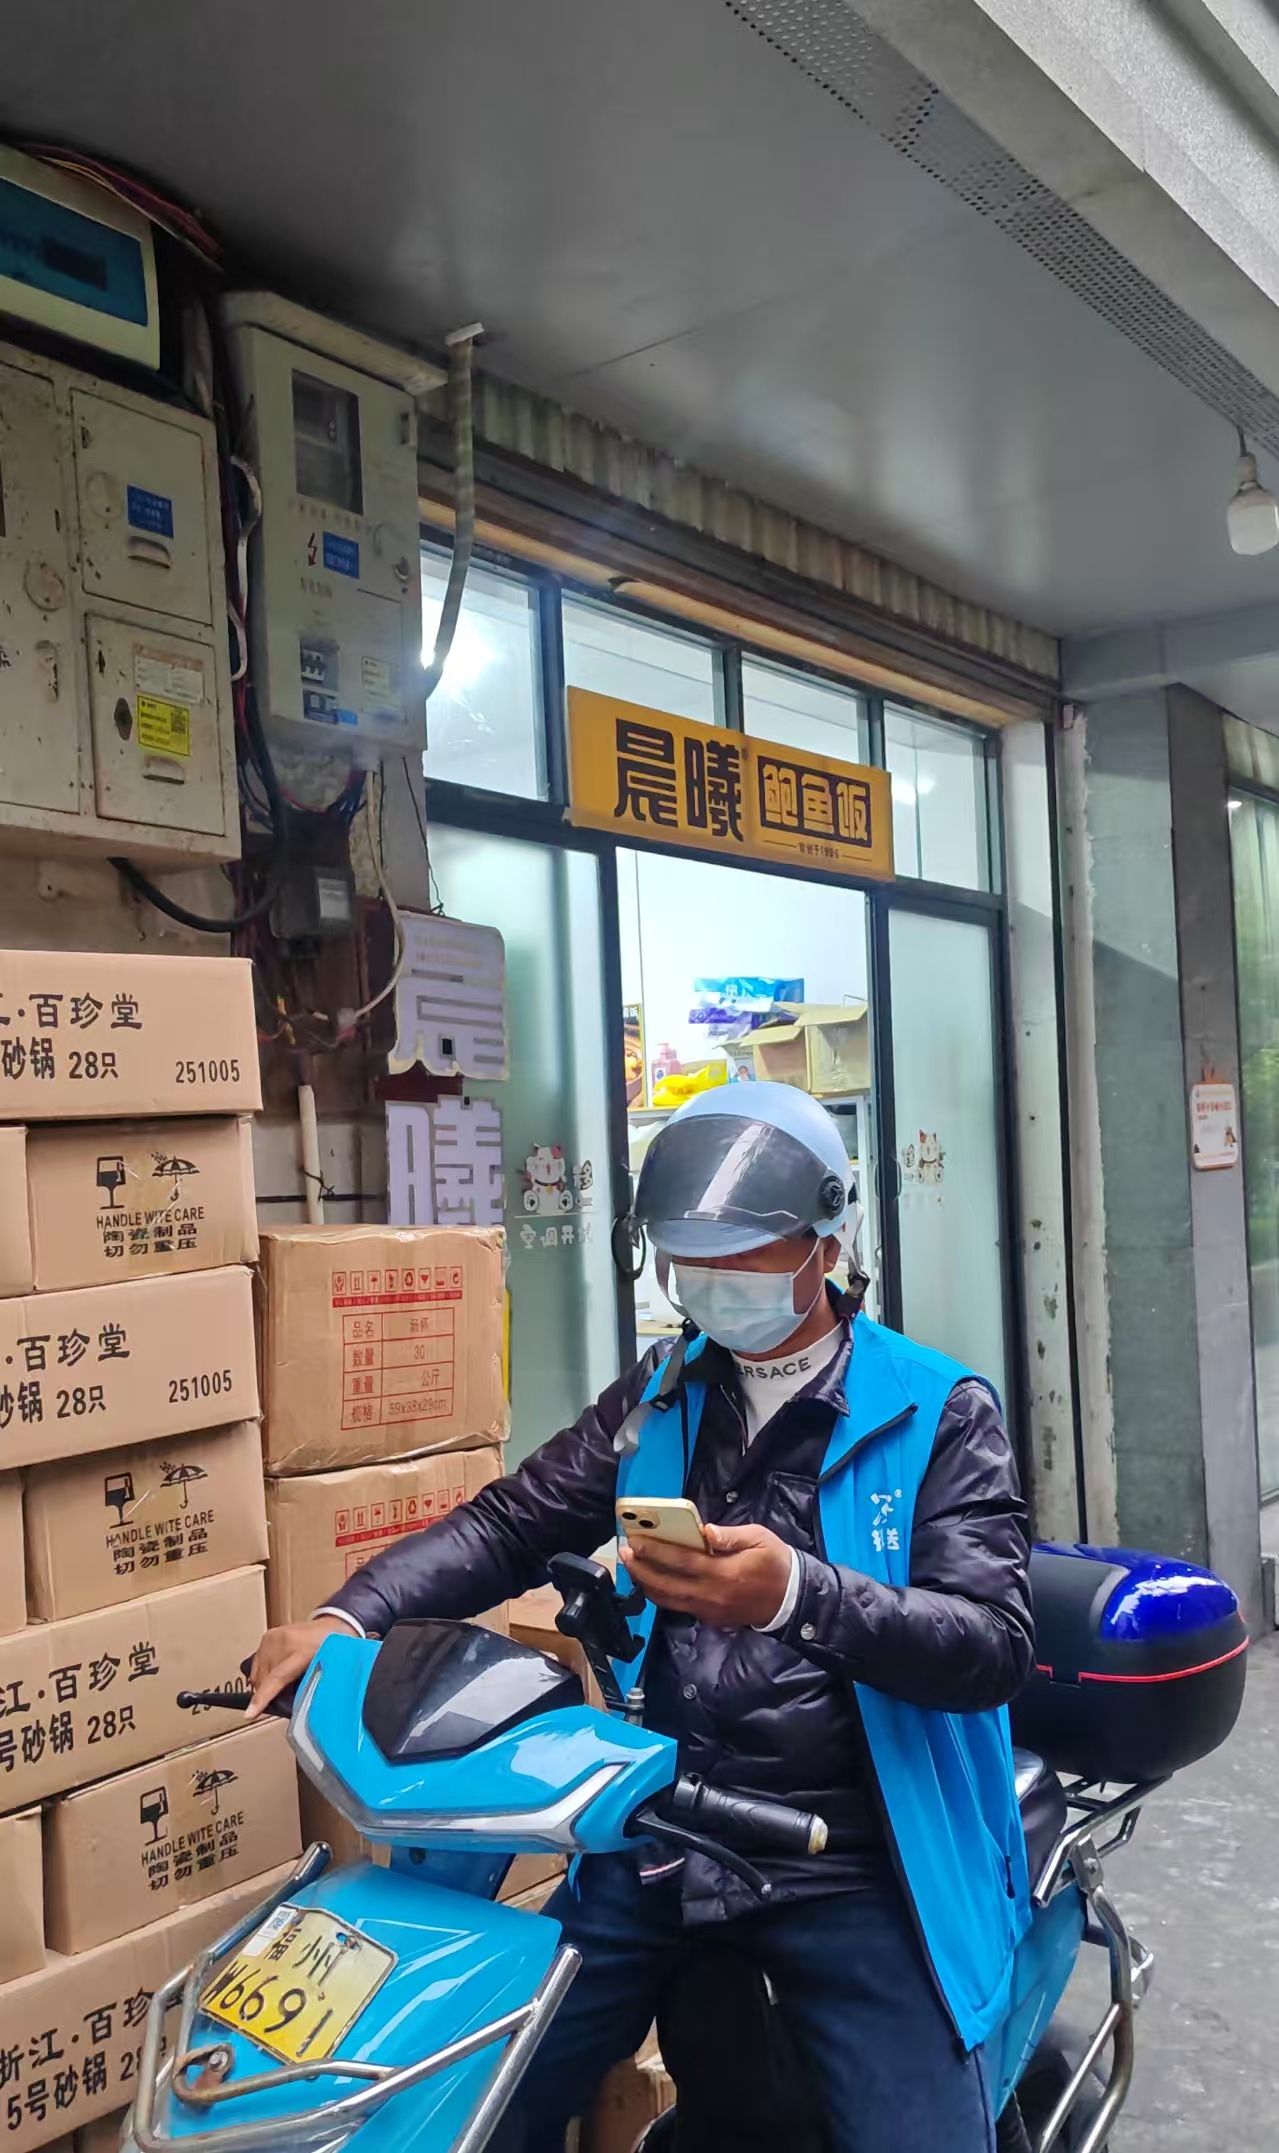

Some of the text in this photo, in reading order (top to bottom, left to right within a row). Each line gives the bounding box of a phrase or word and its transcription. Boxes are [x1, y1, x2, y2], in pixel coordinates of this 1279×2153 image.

[614, 718, 869, 842] 晨曦 鲍鱼饭
[1, 1036, 240, 1084] 砂锅 28只 251005
[96, 1212, 142, 1229] HANDLE
[174, 1207, 204, 1221] CARE
[103, 1223, 197, 1243] 陶瓷制品
[104, 1237, 197, 1257] 切勿重压
[352, 1320, 374, 1338] 品名
[352, 1348, 374, 1367] 数量
[56, 1385, 107, 1419] 28只
[168, 1369, 233, 1403] 251005
[352, 1369, 440, 1395] 重量 公斤
[352, 1405, 372, 1422] 规格
[106, 1510, 214, 1548] HANDLE WITE CARE
[113, 1528, 207, 1562] 陶瓷制品
[113, 1542, 208, 1575] 切勿重压
[87, 1705, 136, 1744] 28只
[141, 1811, 244, 1867] HANDLE WITE CARE
[148, 1831, 238, 1878] 陶瓷制品
[148, 1844, 239, 1890] 切勿重压
[7, 2051, 107, 2130] 5号砂锅
